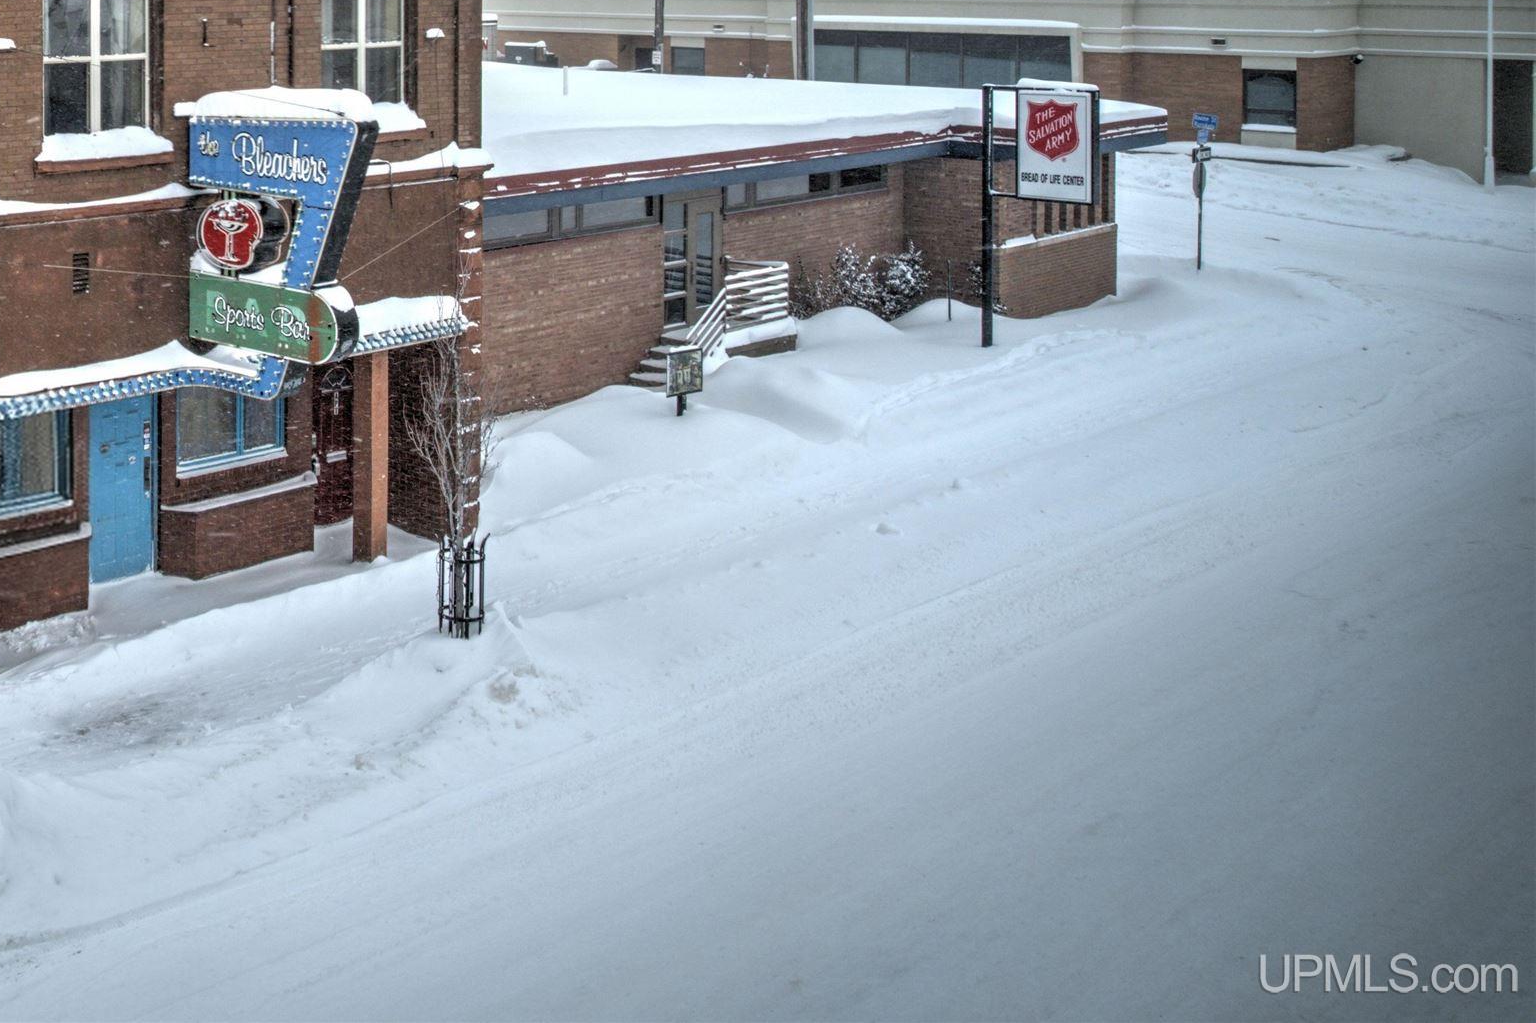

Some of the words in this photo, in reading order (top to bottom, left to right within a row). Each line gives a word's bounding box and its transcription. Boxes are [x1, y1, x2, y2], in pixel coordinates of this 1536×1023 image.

[1028, 111, 1073, 144] SALVATION
[1035, 106, 1056, 125] THE
[1044, 130, 1072, 152] ARMY
[197, 130, 220, 157] the
[232, 131, 328, 185] Bleachers
[1021, 171, 1039, 184] BREAD
[1041, 173, 1048, 184] OF
[1050, 174, 1061, 185] LIFE
[1063, 175, 1084, 186] CENTER
[214, 296, 265, 332] Sports
[271, 306, 311, 341] Bar
